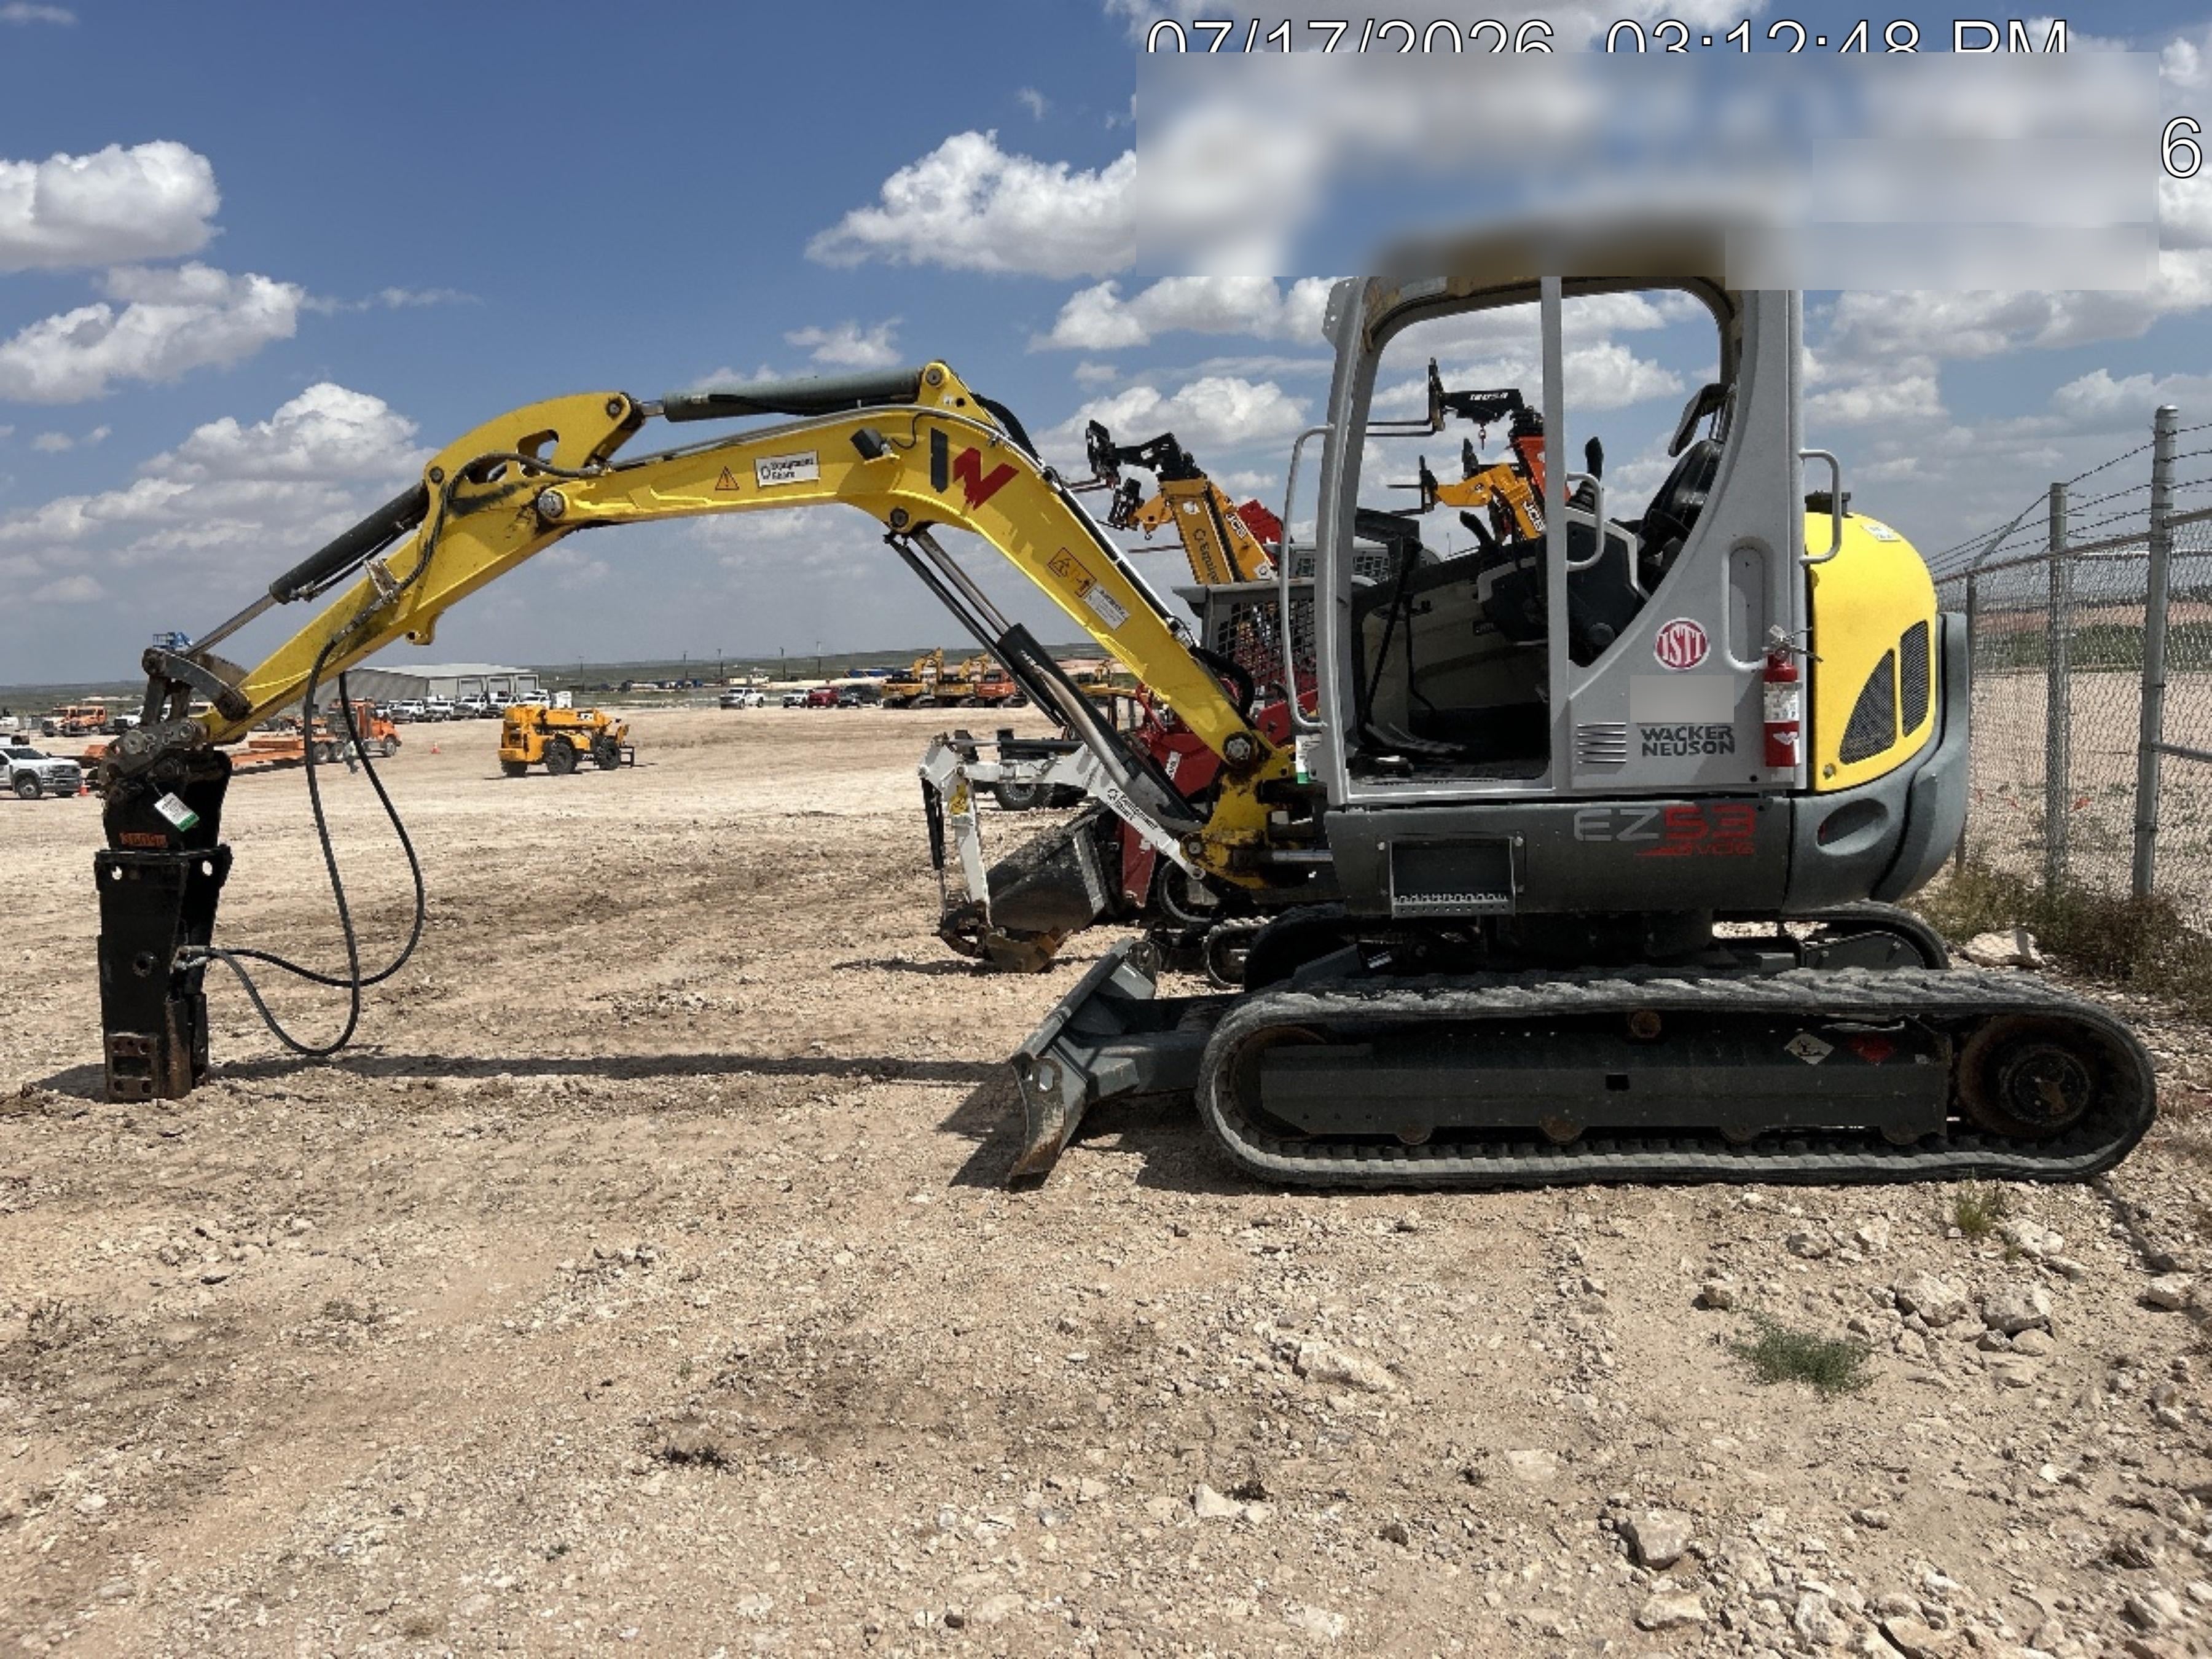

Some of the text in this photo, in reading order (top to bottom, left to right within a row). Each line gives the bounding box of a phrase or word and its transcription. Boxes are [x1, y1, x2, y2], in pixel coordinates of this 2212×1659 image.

[1640, 725, 1735, 742] WACKER
[1642, 740, 1735, 756] NEUSON
[1573, 803, 1757, 842] EZ53
